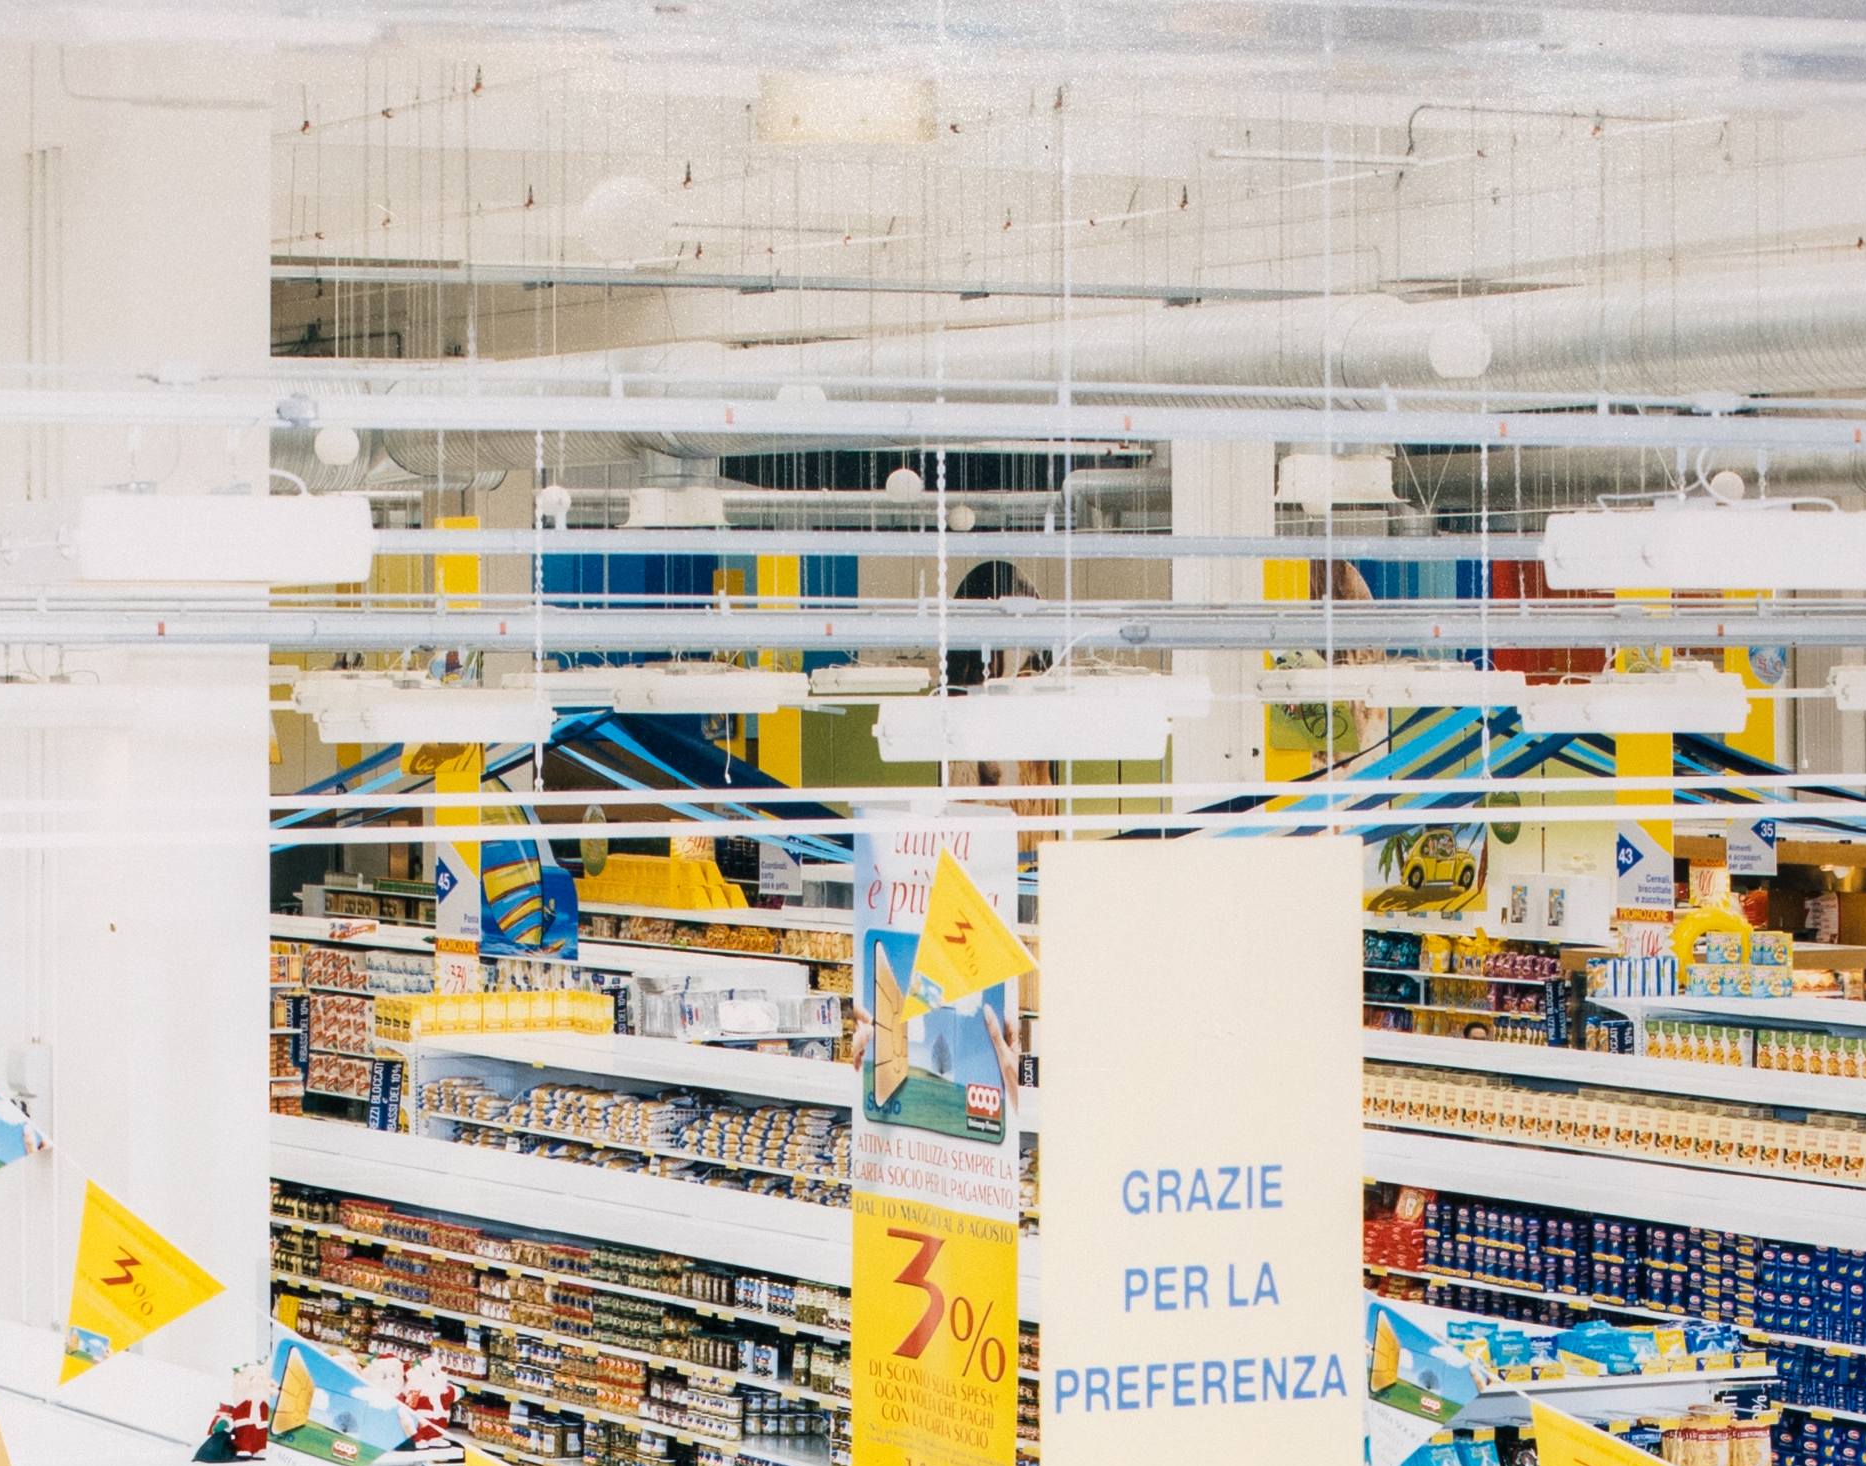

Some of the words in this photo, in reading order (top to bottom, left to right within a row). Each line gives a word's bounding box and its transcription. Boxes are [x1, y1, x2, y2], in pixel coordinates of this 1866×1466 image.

[1759, 823, 1774, 838] 35
[1618, 848, 1633, 864] 43
[437, 873, 451, 890] 45
[373, 1062, 384, 1104] BLOCCATI
[853, 1160, 883, 1183] CARTA
[888, 1165, 923, 1189] SOCIO
[926, 1172, 938, 1193] PER
[858, 1133, 892, 1157] ATTIVA
[897, 1138, 903, 1157] E
[908, 1140, 948, 1167] UTILIZZA
[952, 1150, 994, 1178] SEMPRE
[1000, 1161, 1013, 1180] LA
[1122, 1165, 1283, 1215] GRAZIE
[856, 1197, 877, 1216] DAL
[901, 1205, 942, 1230] MAGGIO
[969, 1221, 1014, 1245] AGOSTO
[1125, 1265, 1210, 1311] PER
[1229, 1261, 1279, 1307] LA
[869, 1359, 882, 1377] DI
[886, 1362, 930, 1388] SCONTO
[1055, 1354, 1347, 1413] PREFERENZA
[874, 1381, 907, 1404] OGNI
[938, 1398, 957, 1419] CHE
[882, 1402, 909, 1423] CON
[913, 1413, 923, 1429] LA
[954, 1425, 989, 1449] SOCIO
